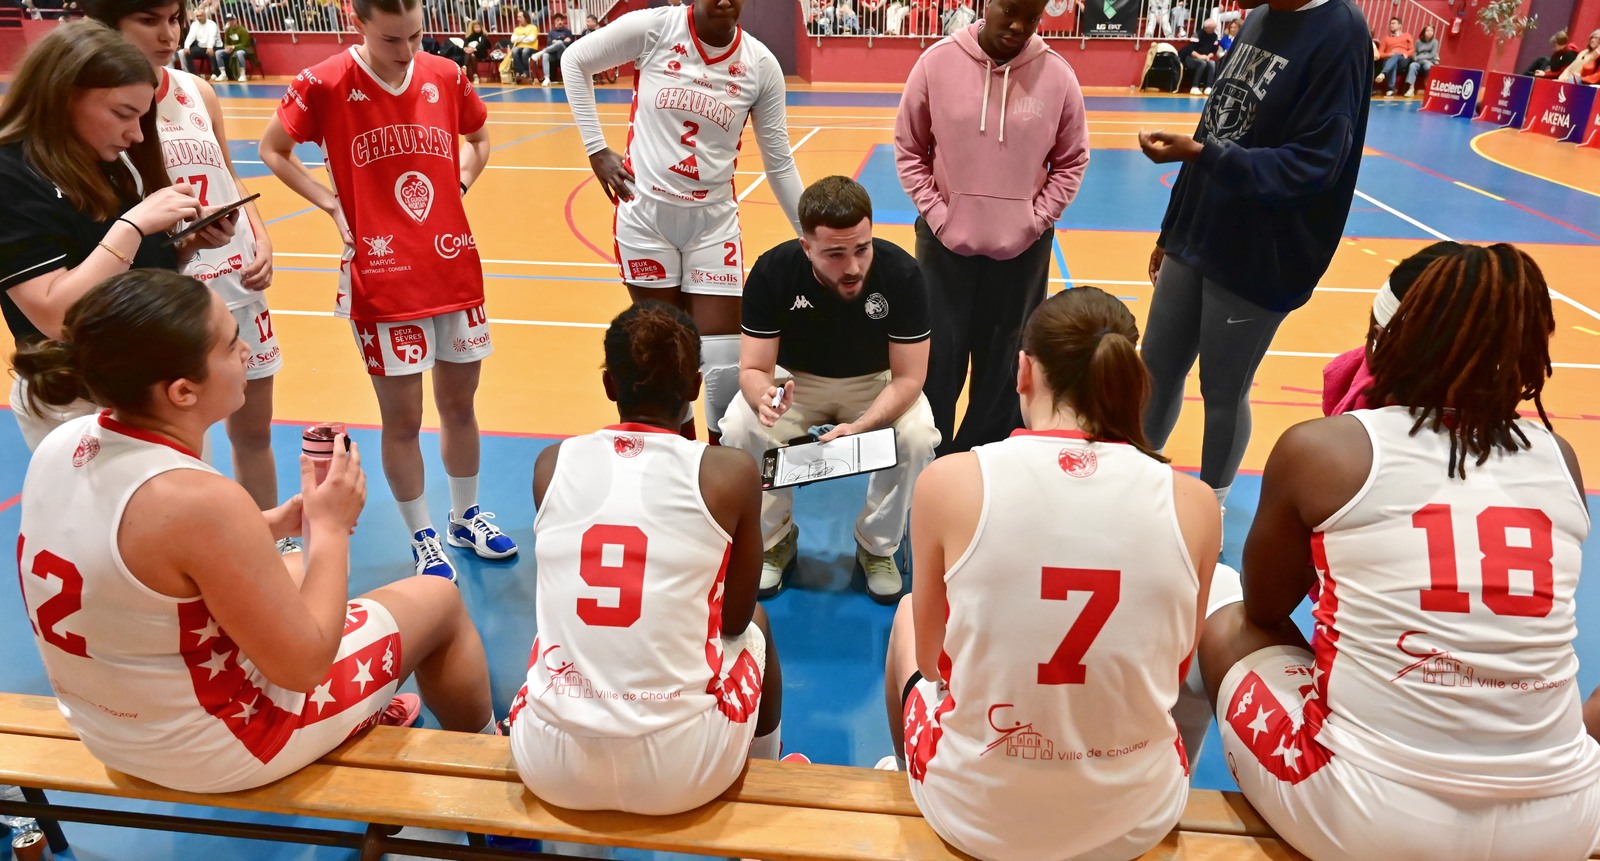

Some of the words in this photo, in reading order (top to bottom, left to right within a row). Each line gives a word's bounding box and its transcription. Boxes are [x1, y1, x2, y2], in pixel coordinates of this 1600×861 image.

[1217, 43, 1289, 101] NIKE
[693, 79, 713, 89] AKENA
[1430, 79, 1462, 95] E.Leclerc
[655, 87, 736, 132] CHAURAY
[1013, 96, 1045, 118] NIKE
[160, 125, 184, 133] AKENA
[1541, 109, 1570, 128] AKENA
[680, 120, 699, 148] 2
[352, 124, 453, 167] CHAURAY
[674, 163, 698, 174] MAIF
[175, 174, 209, 206] 7
[370, 258, 396, 267] MARVIC
[723, 242, 737, 267] 2
[255, 309, 274, 343] 17
[394, 327, 412, 336] DEUX
[397, 344, 423, 364] 79
[1411, 503, 1554, 618] 18
[576, 523, 648, 628] 9
[17, 532, 93, 659] 2
[1037, 566, 1121, 685] 7
[1478, 677, 1505, 689] Ville
[1511, 680, 1528, 691] de
[596, 690, 619, 700] Ville
[622, 692, 637, 701] de
[1058, 751, 1083, 761] Ville
[1087, 747, 1102, 758] de
[1107, 739, 1149, 757] Chauray
